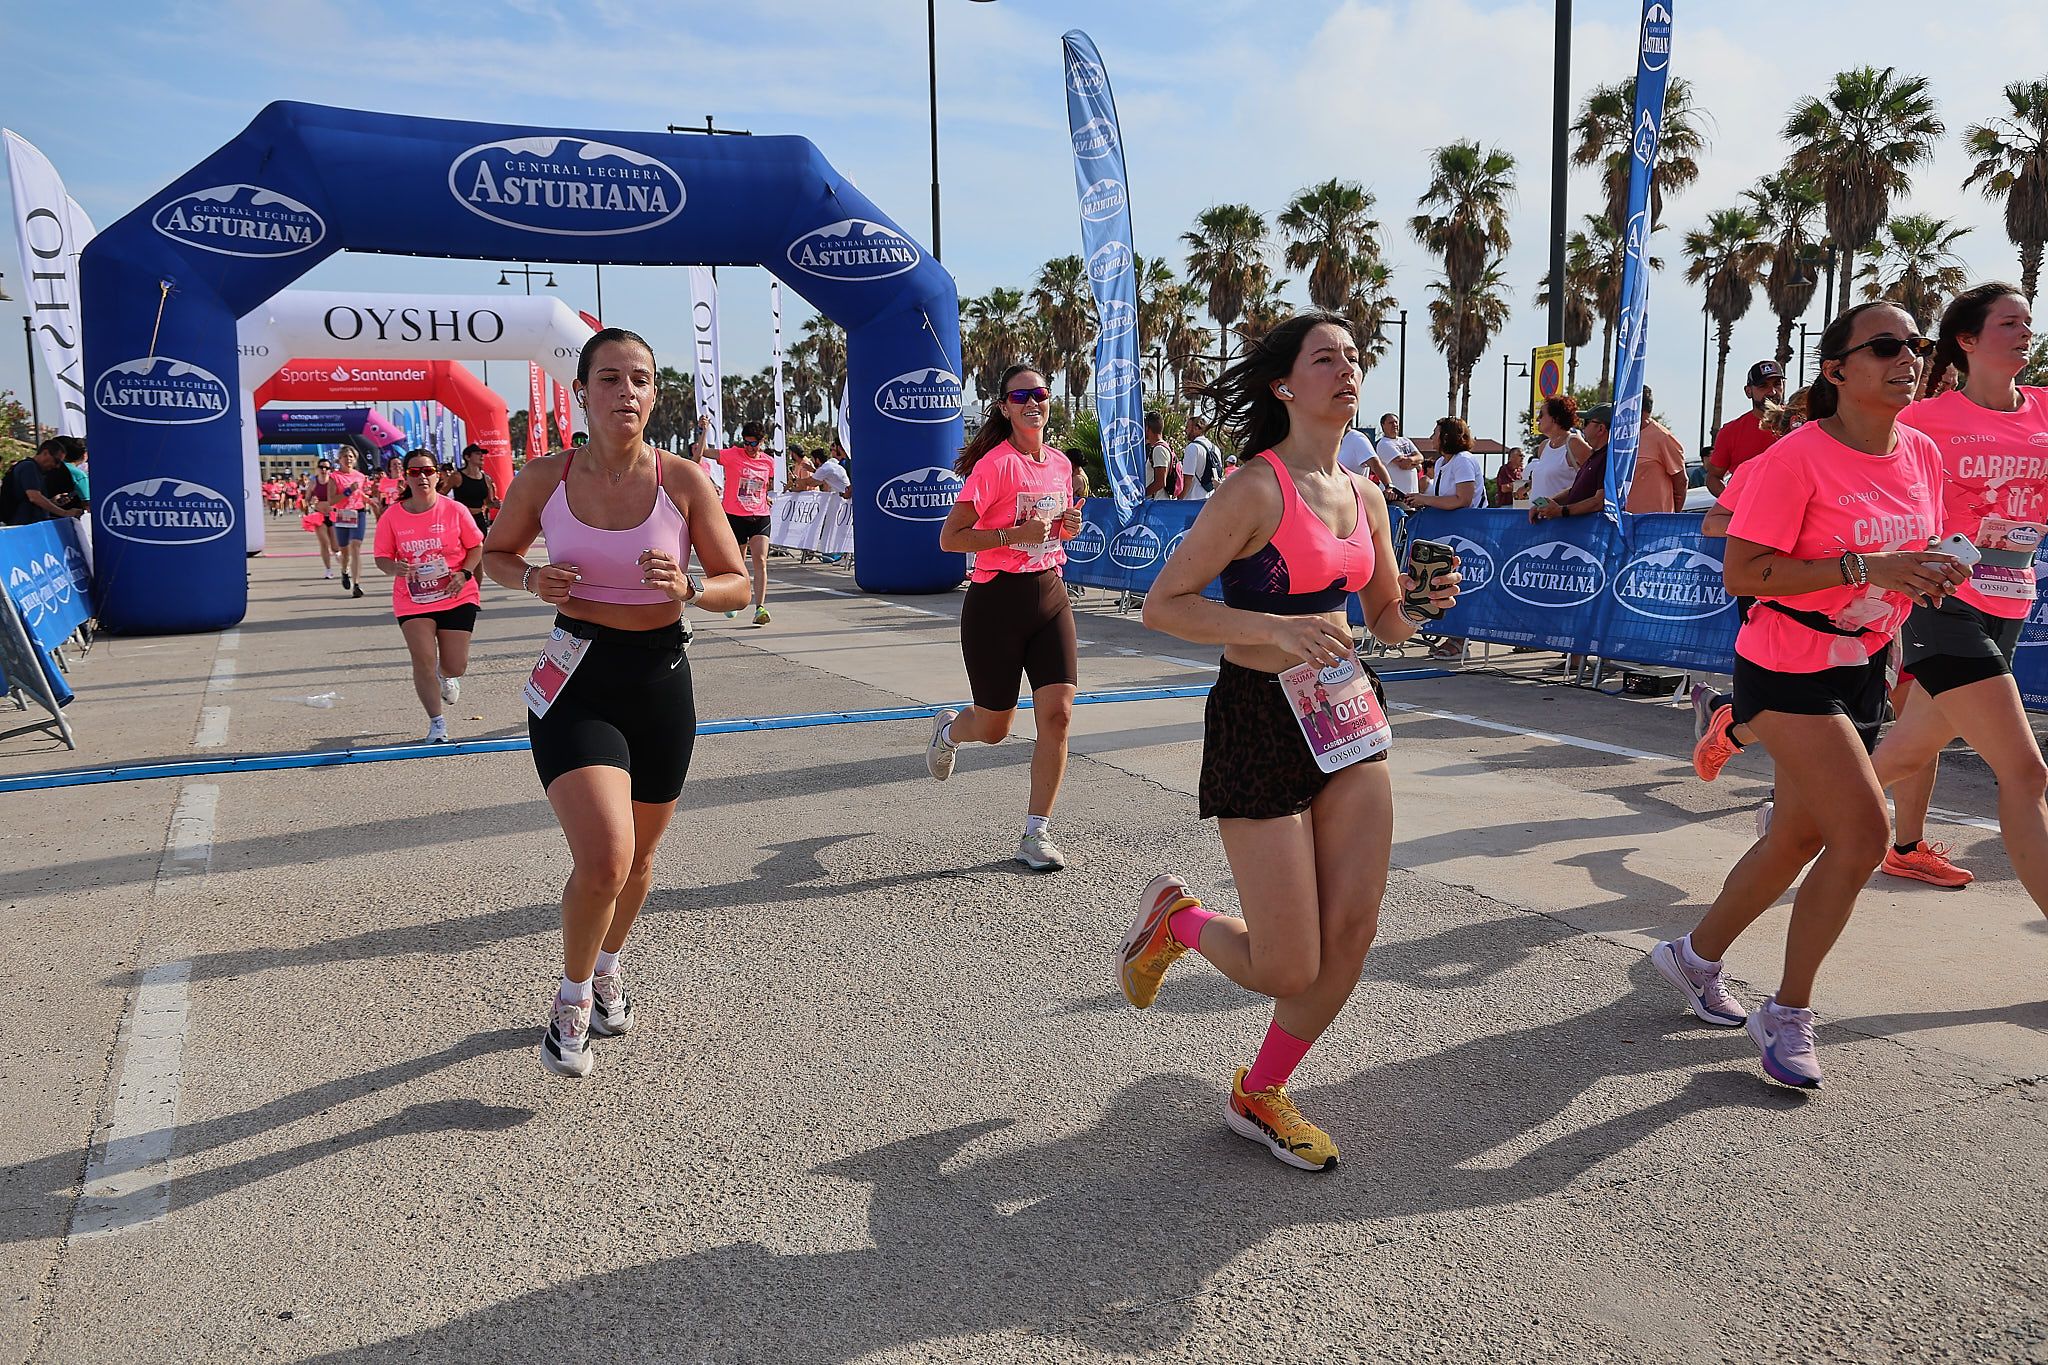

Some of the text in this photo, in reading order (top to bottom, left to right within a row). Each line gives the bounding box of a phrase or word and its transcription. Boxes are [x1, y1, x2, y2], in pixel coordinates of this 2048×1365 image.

[504, 160, 662, 180] CENTRAL LECHERA
[468, 160, 670, 213] ASTURIANA
[193, 205, 312, 223] CENTRAL LECHERA
[164, 206, 313, 244] ASTURIANA
[819, 238, 906, 249] CENTRAL LECHERA
[799, 244, 915, 266] ASTURIANA
[324, 305, 504, 343] OYSHO
[119, 378, 220, 391] CENTRAL LECHERA
[281, 368, 427, 384] Sports Santander
[101, 380, 223, 410] ASTURIANA
[1951, 434, 1996, 445] OYSHO
[1959, 454, 2048, 480] CARRERA
[125, 500, 224, 509] CENTRAL LECHERA
[1838, 490, 1880, 506] OYSHO
[107, 501, 228, 528] ASTURIANA
[781, 499, 820, 524] OYSHO
[400, 537, 443, 552] CARRERA
[1111, 538, 1155, 559] ASTURIANA
[1525, 562, 1596, 575] CENTRAL LECHERA
[419, 579, 439, 589] 016
[1506, 562, 1595, 594] ASTURIANA
[1619, 571, 1727, 605] ASTURIANA
[1980, 583, 2009, 593] OYSHO
[1291, 671, 1316, 686] SUMA
[1335, 694, 1370, 722] 016
[1323, 737, 1347, 751] CARRERA
[1346, 733, 1354, 741] DE
[1329, 745, 1361, 763] OYSHO
